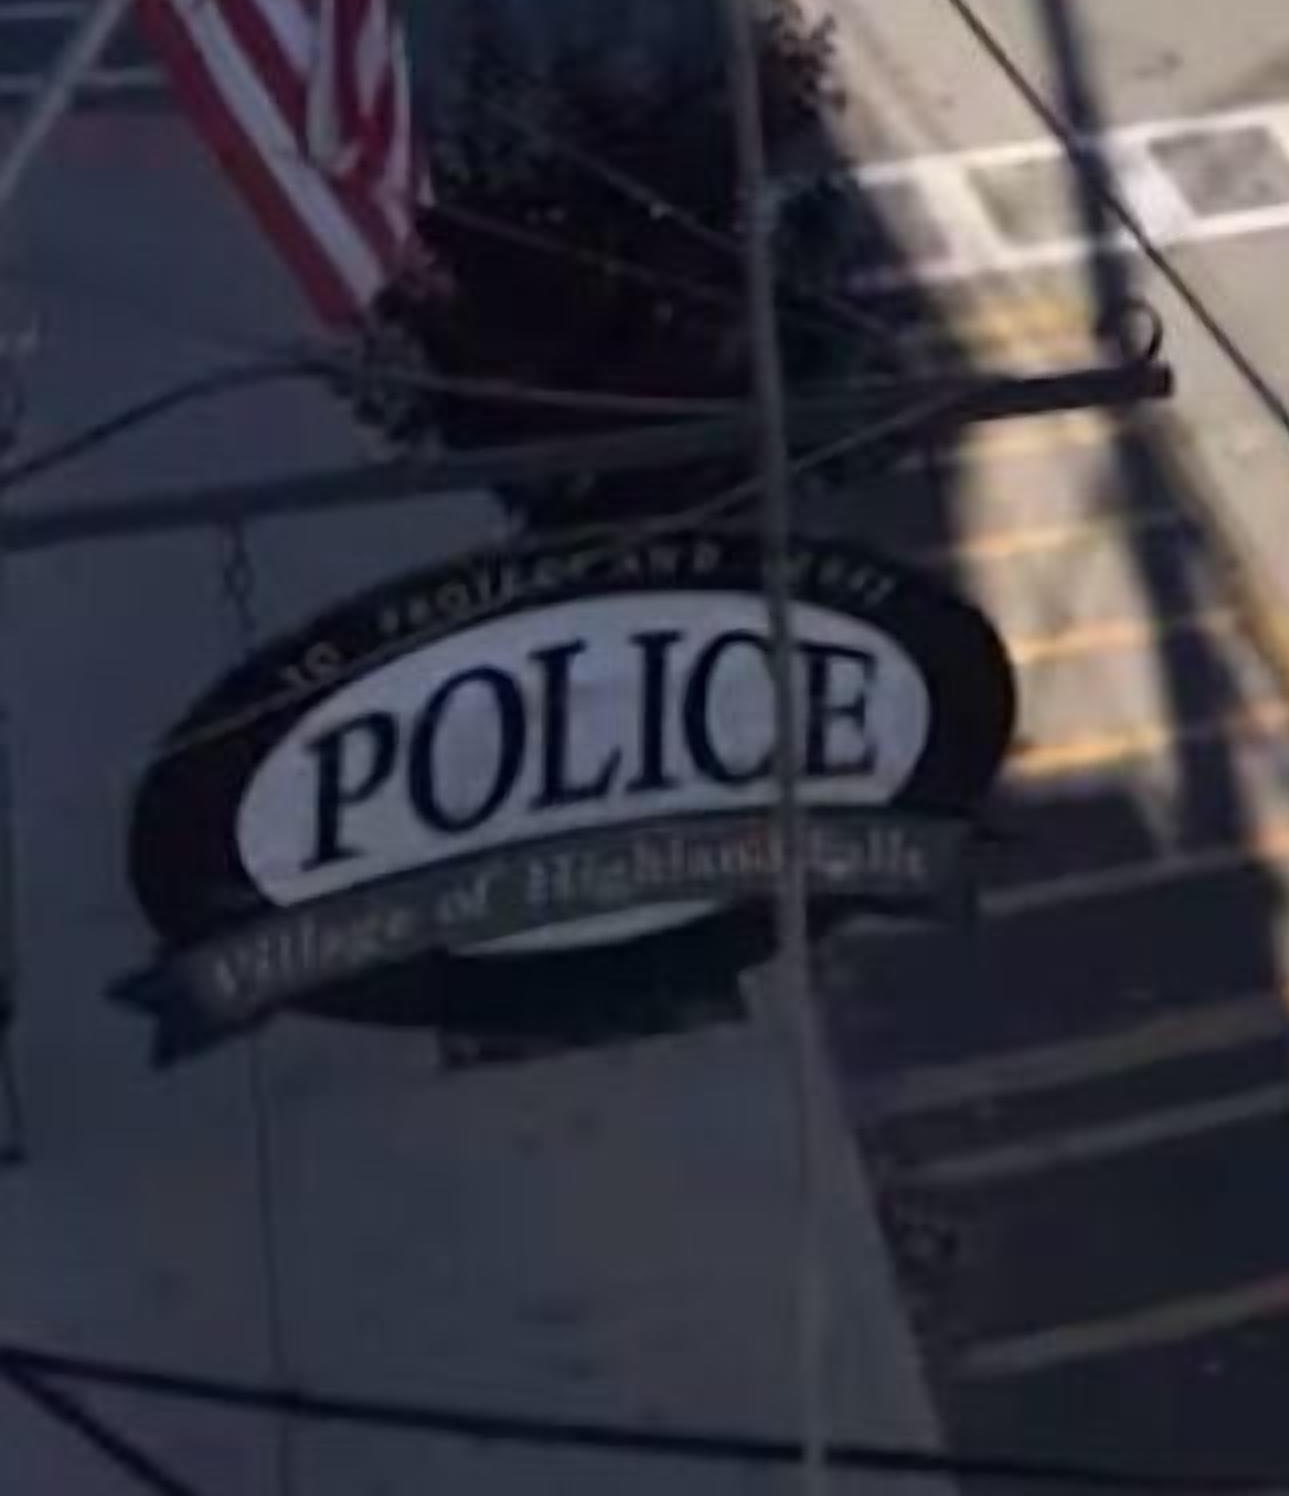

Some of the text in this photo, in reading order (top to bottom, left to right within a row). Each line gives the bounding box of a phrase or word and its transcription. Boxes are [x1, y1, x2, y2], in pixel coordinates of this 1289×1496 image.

[298, 627, 881, 874] POLICE
[210, 905, 416, 1004] Village
[434, 859, 511, 926] of
